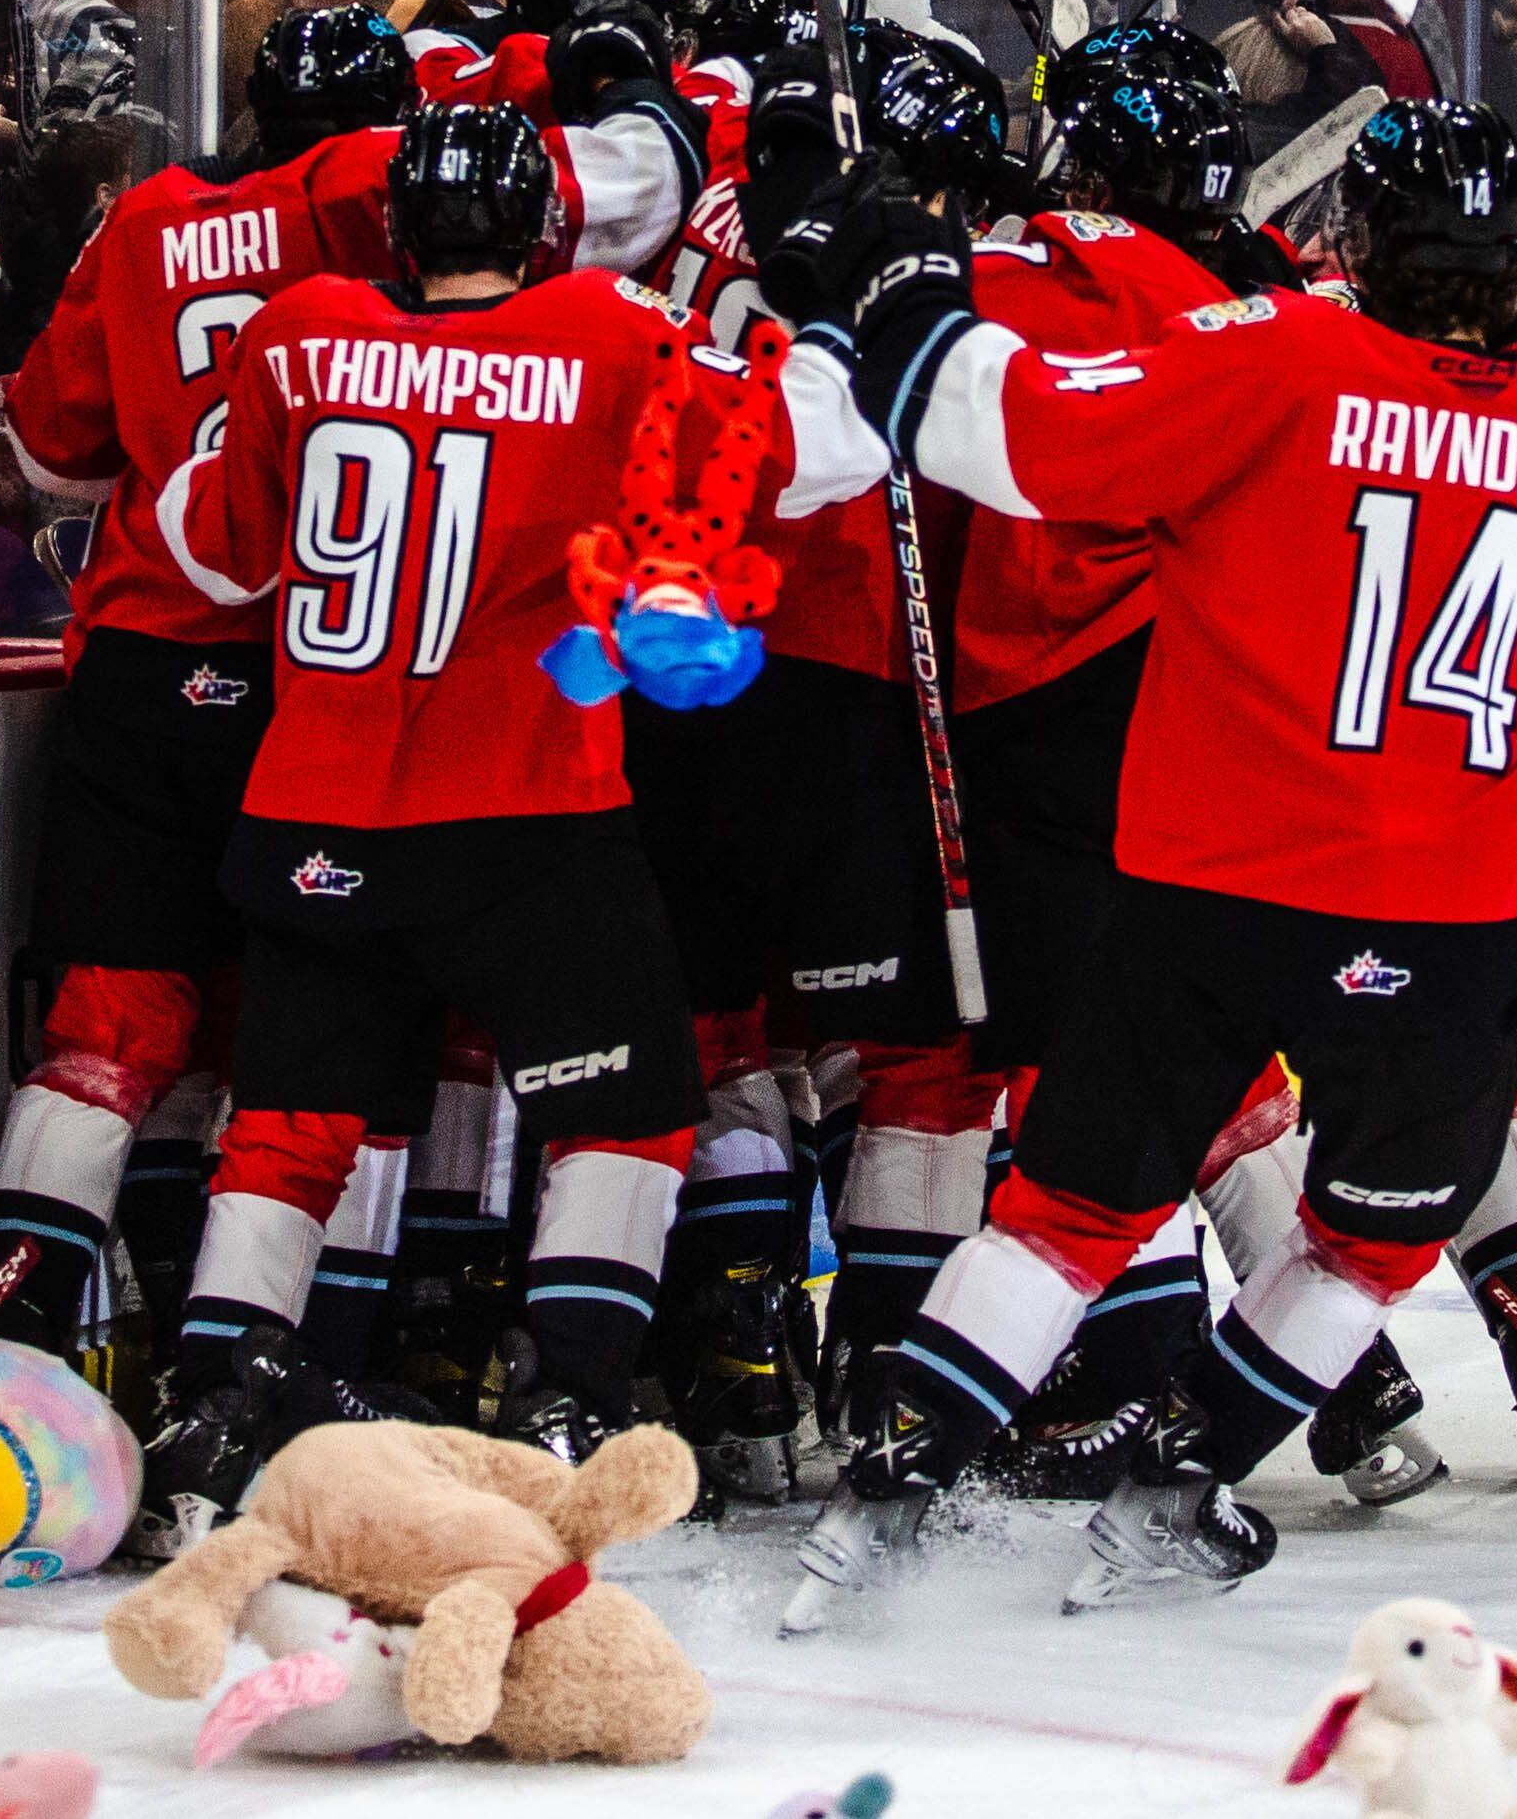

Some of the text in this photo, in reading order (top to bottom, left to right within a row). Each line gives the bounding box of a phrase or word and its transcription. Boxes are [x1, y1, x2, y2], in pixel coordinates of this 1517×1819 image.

[298, 54, 317, 88] 2
[1032, 54, 1048, 103] CCM
[889, 91, 925, 126] 16
[1203, 163, 1233, 199] 67
[1462, 176, 1493, 216] 14
[161, 207, 281, 289] MORI
[284, 417, 495, 680] 91
[889, 465, 938, 682] JETSPEED
[792, 957, 899, 991] CCM
[514, 1044, 630, 1094] CCM
[1327, 1180, 1457, 1209] CCM
